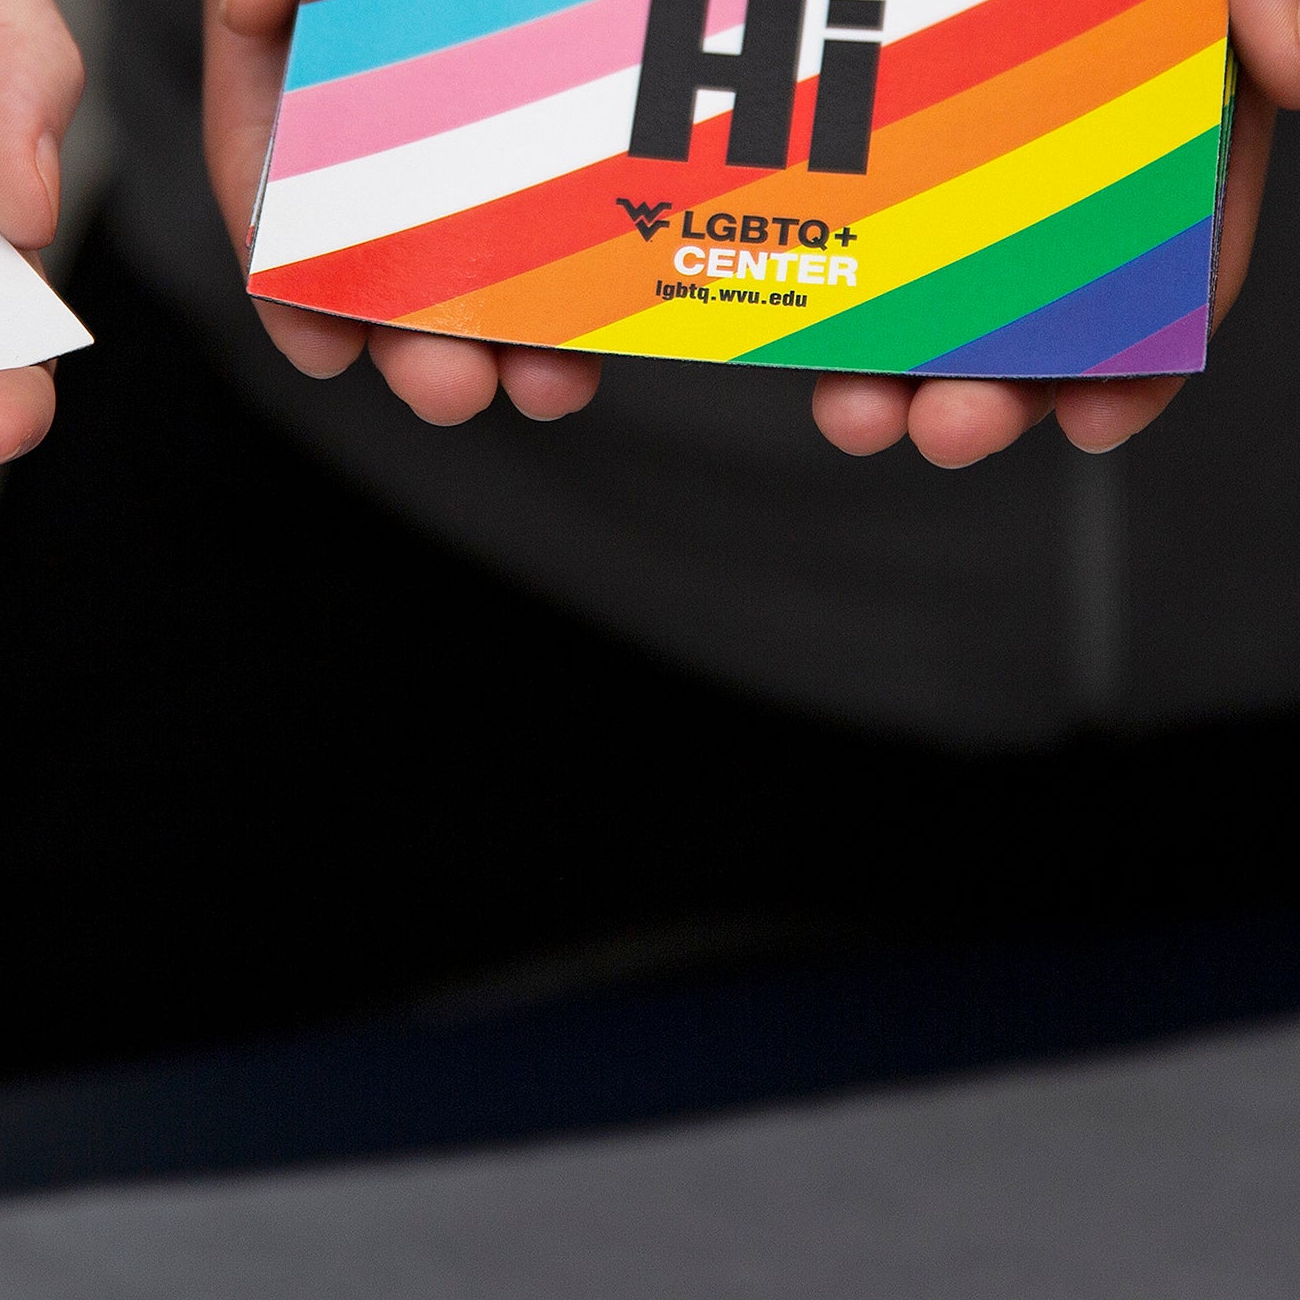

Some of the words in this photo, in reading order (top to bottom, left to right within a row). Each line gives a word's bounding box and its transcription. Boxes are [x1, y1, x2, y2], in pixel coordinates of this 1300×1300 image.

[681, 210, 858, 252] LGBTQ+
[673, 245, 859, 287] CENTER
[655, 280, 808, 308] lgbtq.wvu.edu
